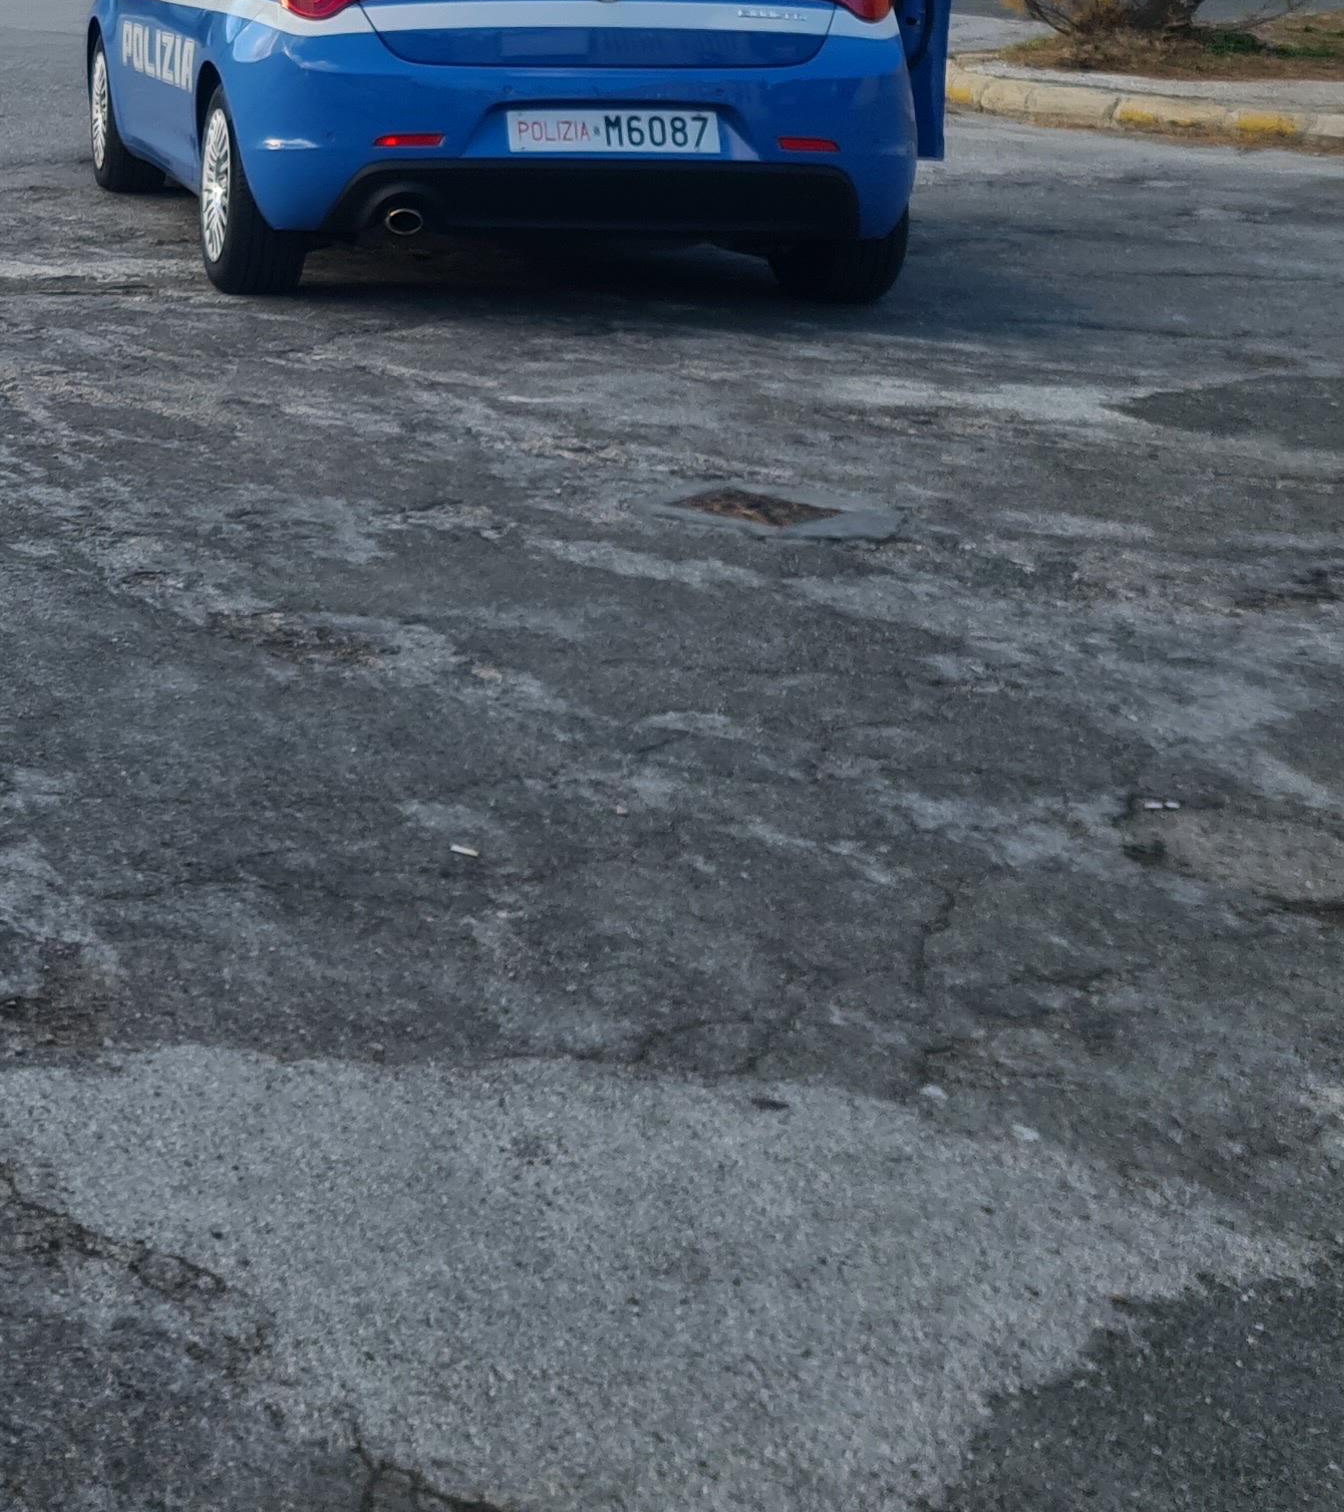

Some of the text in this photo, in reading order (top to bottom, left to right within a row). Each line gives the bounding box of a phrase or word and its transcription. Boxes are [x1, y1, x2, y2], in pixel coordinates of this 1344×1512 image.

[121, 19, 196, 94] POLIZIA
[517, 114, 709, 148] POLIZIA M6087
